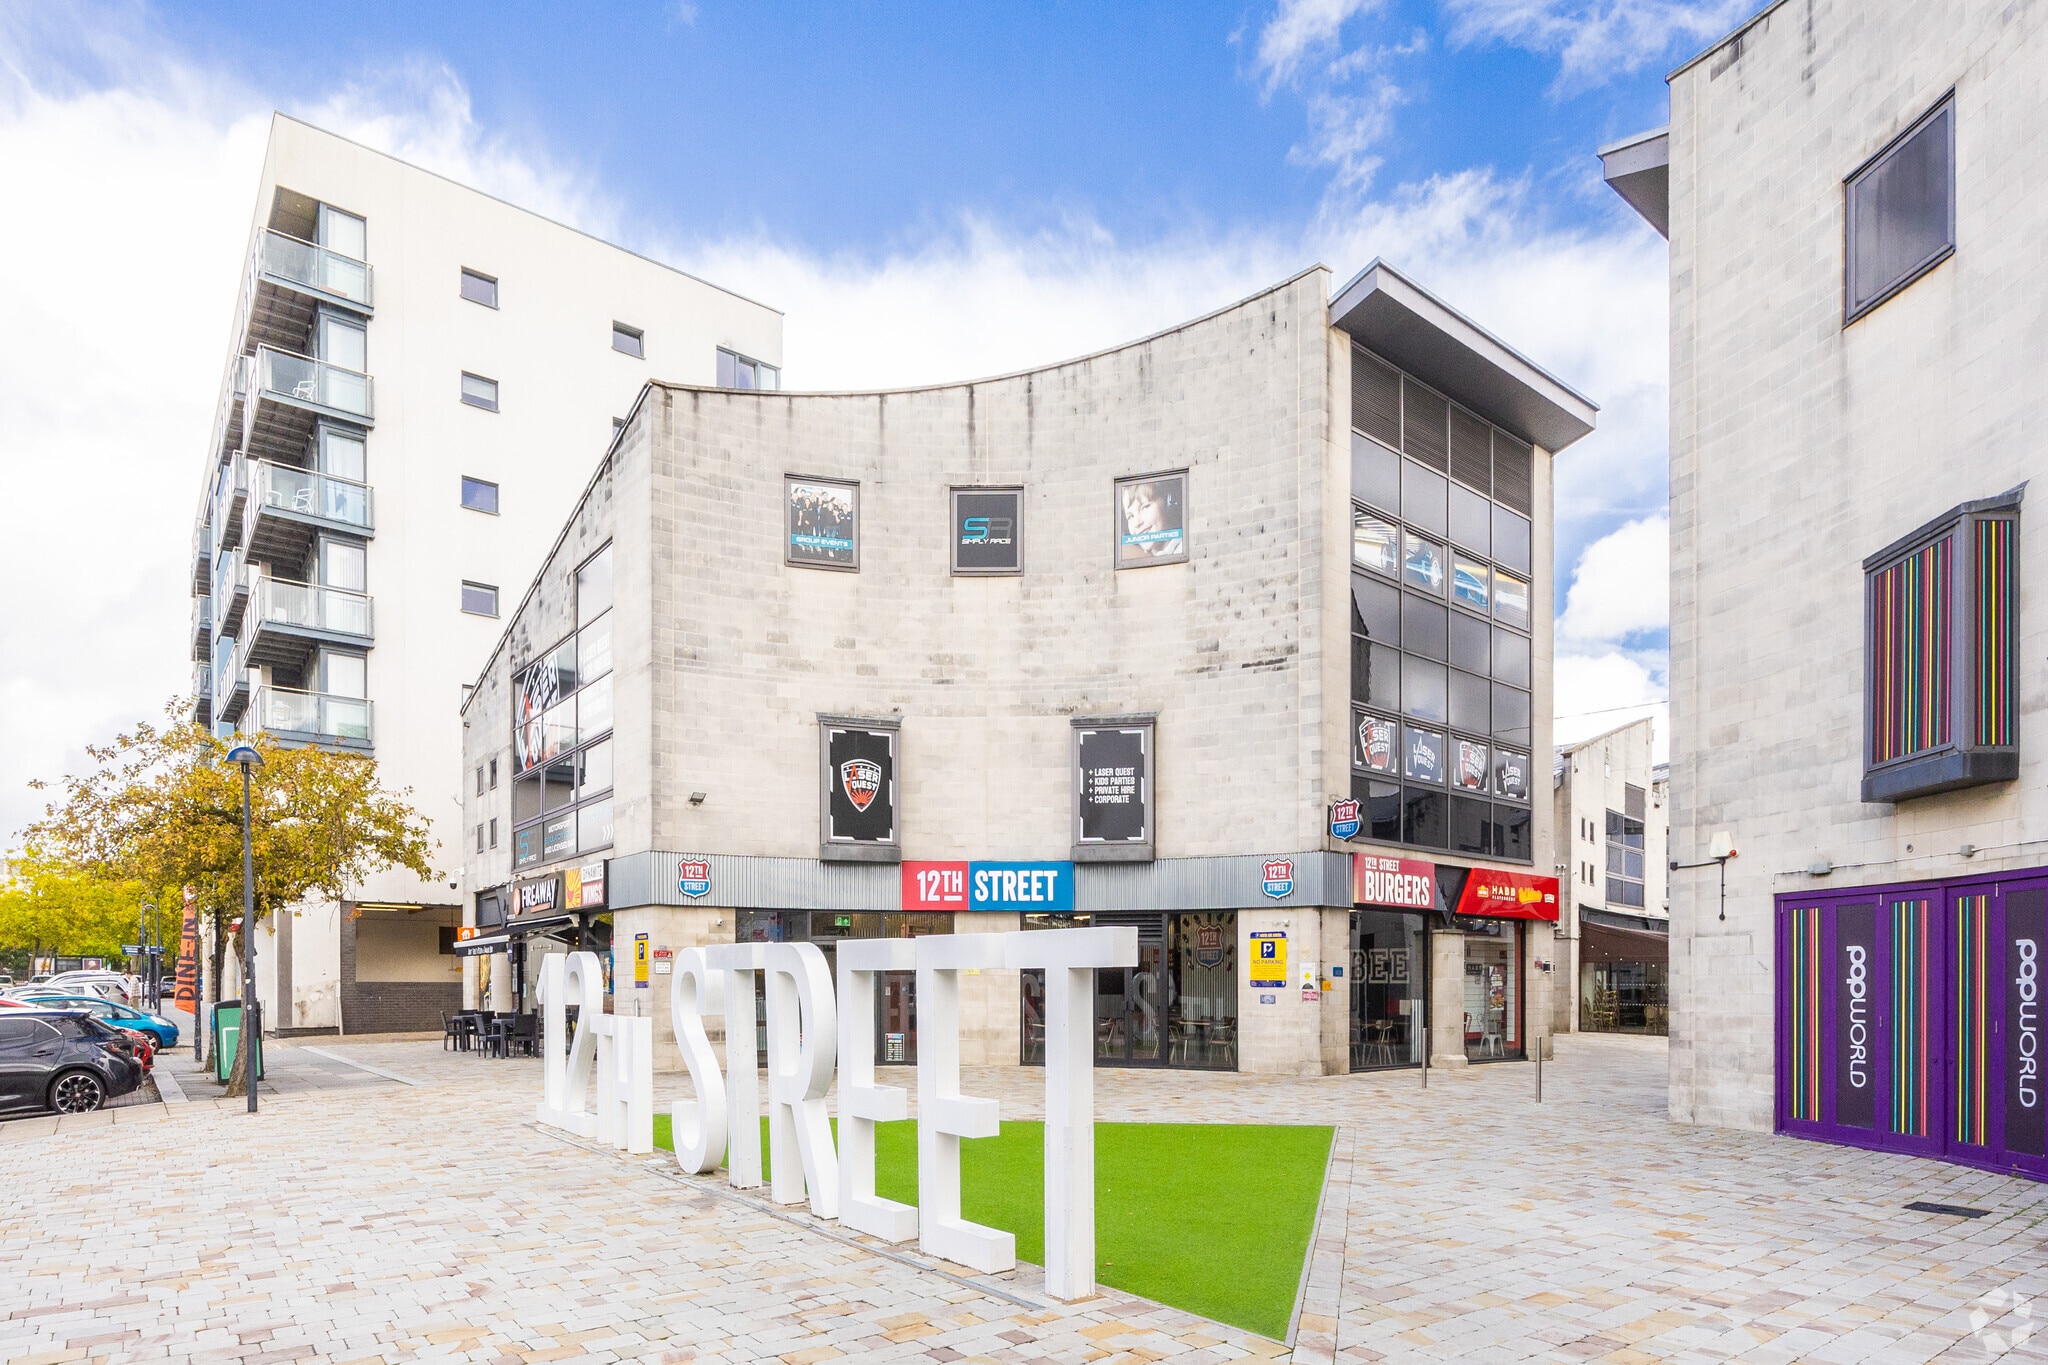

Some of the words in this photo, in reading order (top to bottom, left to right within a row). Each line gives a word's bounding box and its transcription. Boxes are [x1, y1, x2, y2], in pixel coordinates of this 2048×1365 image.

[821, 538, 848, 547] EVENTS
[1126, 535, 1150, 543] JUNIOR
[1151, 531, 1178, 539] PARTIES
[1369, 742, 1389, 756] QUEST
[1413, 736, 1435, 763] LASER
[1417, 755, 1434, 770] QUEST
[844, 764, 879, 783] LASER
[1095, 768, 1114, 776] LASER
[1115, 767, 1134, 776] QUEST
[1502, 760, 1521, 779] LASER
[851, 780, 877, 791] QUEST
[1095, 777, 1109, 785] KIDS
[1110, 777, 1135, 785] PARTIES
[1095, 786, 1119, 794] PRIVATE
[1121, 786, 1135, 794] HIRE
[1095, 795, 1129, 803] CORPORATE
[1337, 806, 1353, 820] 12TH
[1336, 822, 1354, 833] STREET
[1365, 857, 1377, 869] 12TH
[1379, 858, 1400, 872] STREET
[684, 865, 703, 878] 12TH
[1268, 865, 1286, 878] 12TH
[684, 881, 705, 891] STREET
[916, 869, 963, 902] 12TH
[974, 869, 1058, 902] STREET
[1267, 882, 1288, 892] STREET
[1365, 870, 1430, 906] BURGERS
[521, 878, 556, 909] FIREAWAY
[583, 883, 602, 904] WINGS
[1201, 931, 1217, 945] 12TH
[1200, 951, 1219, 960] STREET
[535, 951, 653, 1155] 12TH
[671, 926, 1139, 1301] STREET
